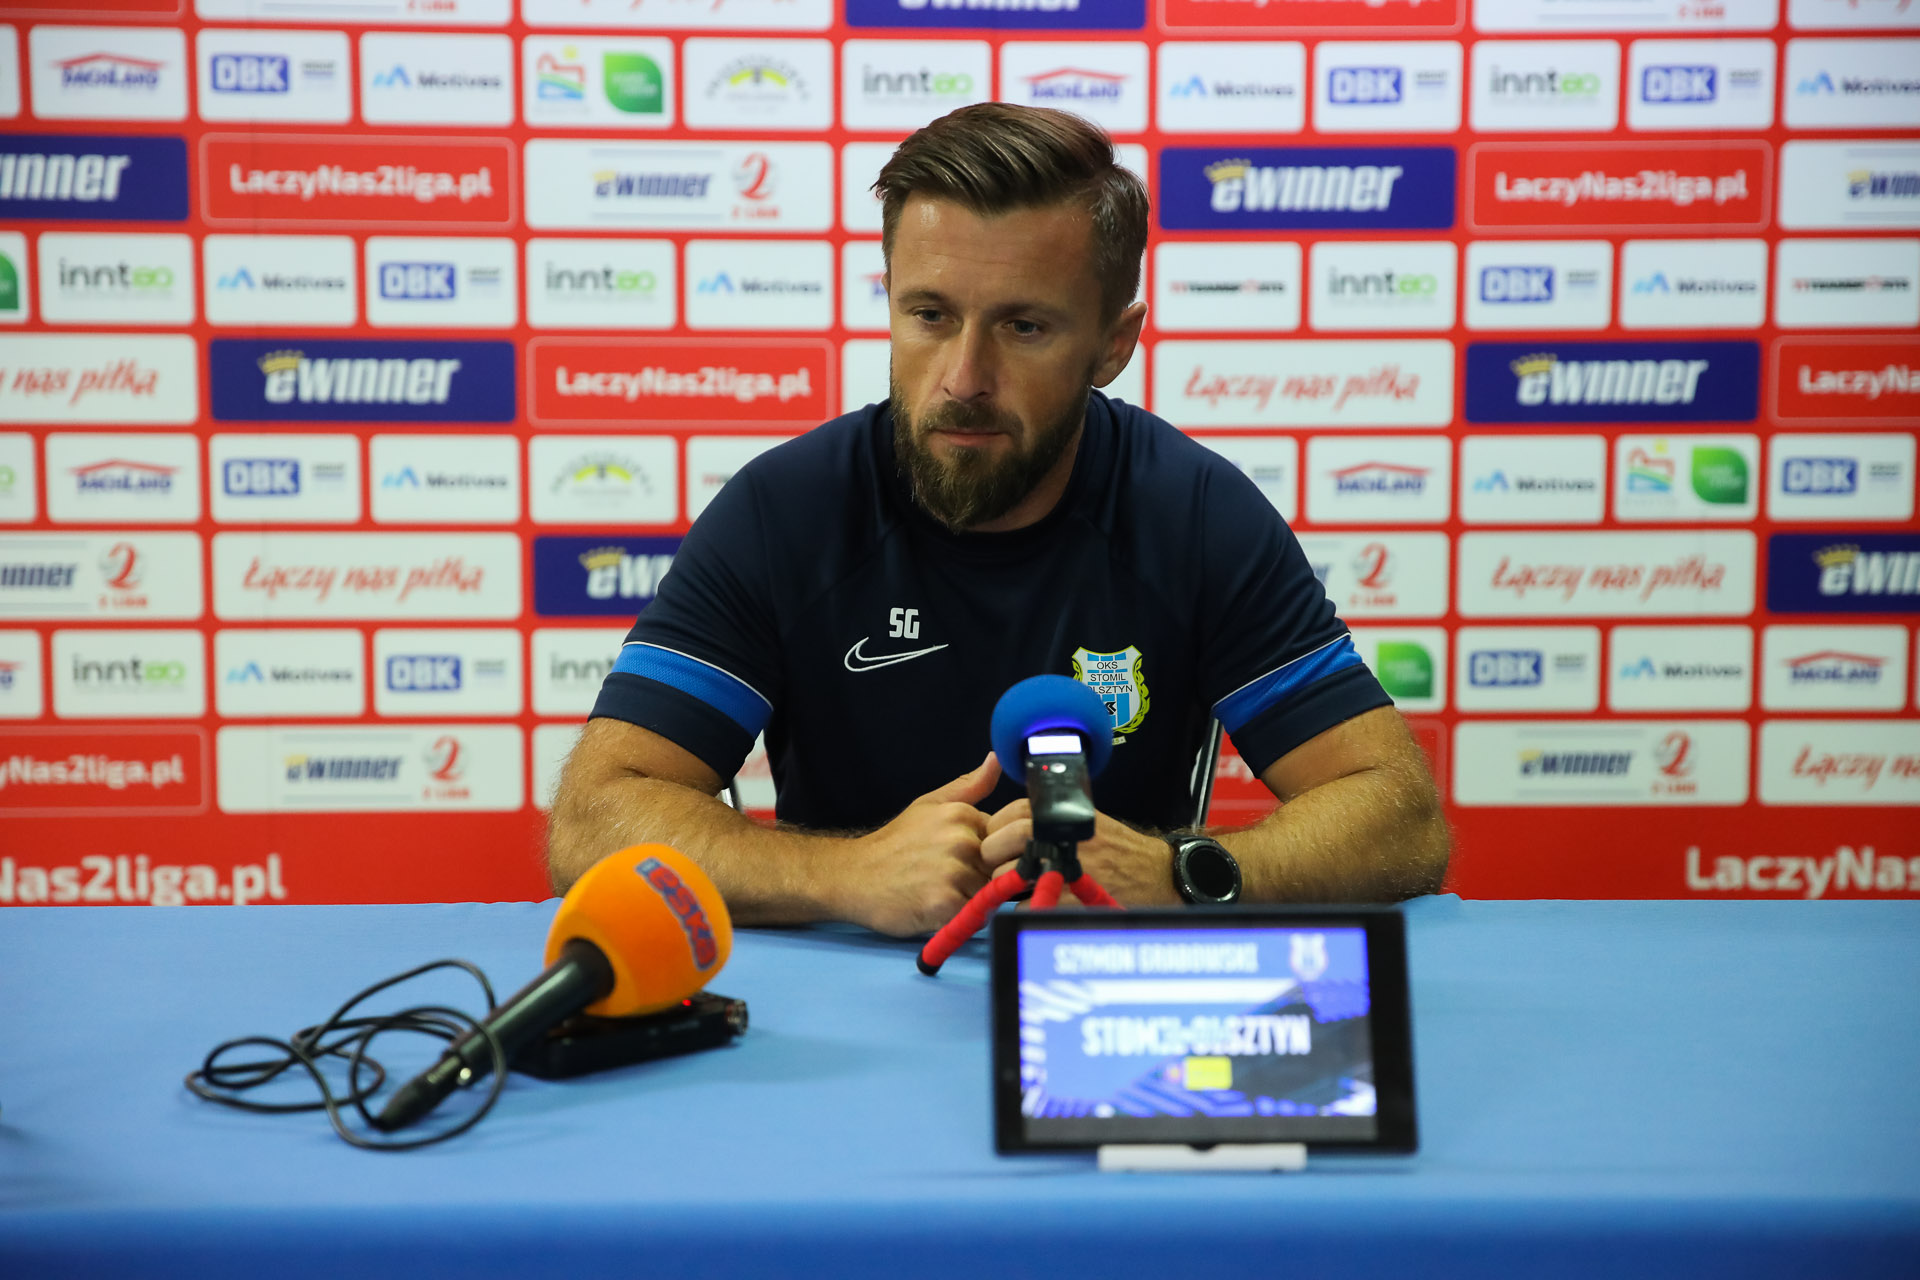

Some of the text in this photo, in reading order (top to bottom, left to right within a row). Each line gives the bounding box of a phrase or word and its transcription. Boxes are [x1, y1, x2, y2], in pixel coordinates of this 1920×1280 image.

[216, 58, 287, 91] DBK
[1333, 70, 1400, 100] DBK
[1646, 69, 1715, 99] DBK
[230, 164, 492, 202] LaczyNas2liga.pl
[1495, 170, 1748, 206] LaczyNas2liga.pl
[384, 265, 453, 298] DBK
[1483, 269, 1553, 301] DBK
[11, 369, 69, 395] nas
[556, 367, 811, 402] LaczyNas2liga.pl
[1282, 376, 1337, 401] nas
[228, 461, 298, 494] DBK
[1784, 460, 1855, 493] DBK
[343, 566, 399, 593] nas
[1589, 566, 1643, 591] nas
[889, 607, 919, 639] SG
[391, 658, 459, 689] DBK
[1090, 673, 1127, 682] STOMIL
[1096, 661, 1119, 670] OKS
[1471, 653, 1540, 685] DBK
